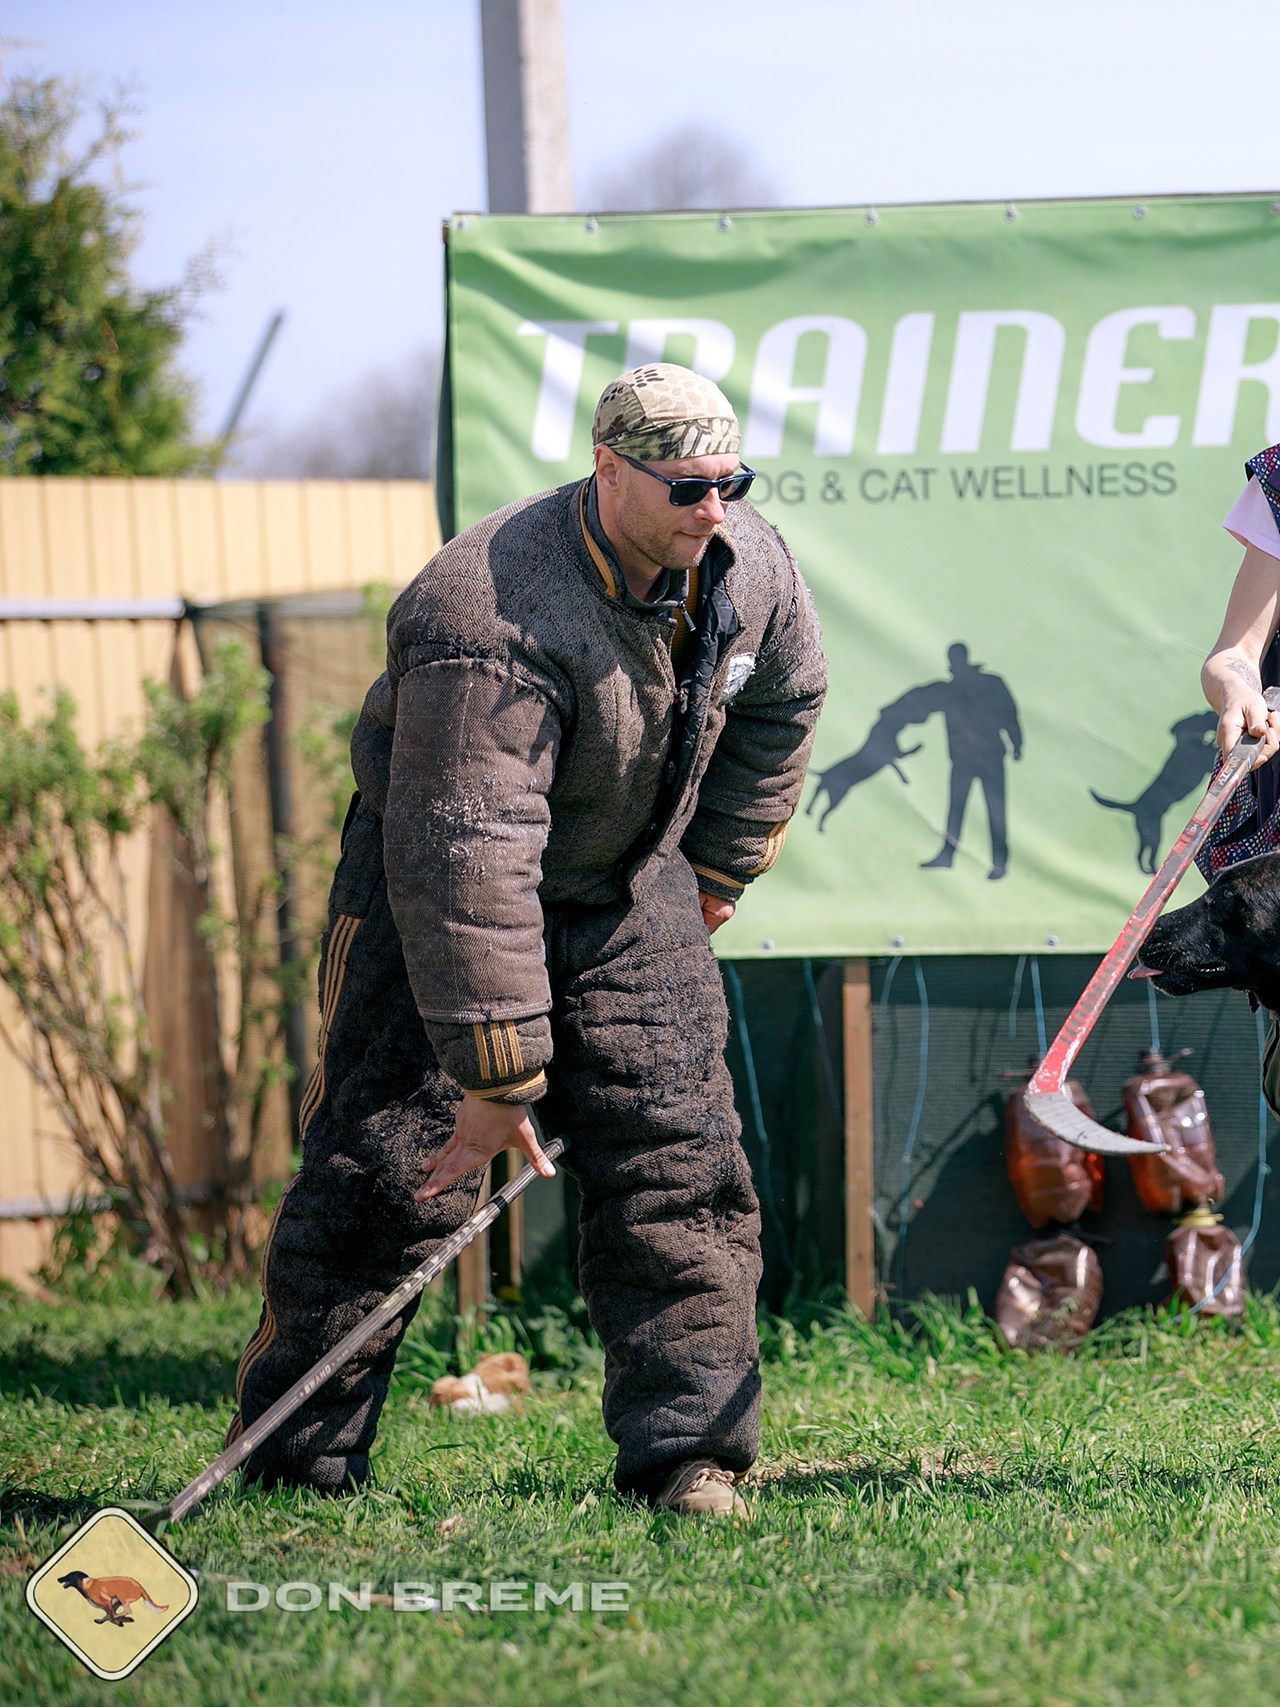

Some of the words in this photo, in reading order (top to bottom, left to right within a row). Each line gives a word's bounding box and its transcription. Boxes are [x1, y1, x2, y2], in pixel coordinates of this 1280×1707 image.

[754, 470, 805, 502] OG
[820, 469, 846, 502] &
[859, 467, 938, 501] CAT
[949, 461, 1177, 499] WELLNESS
